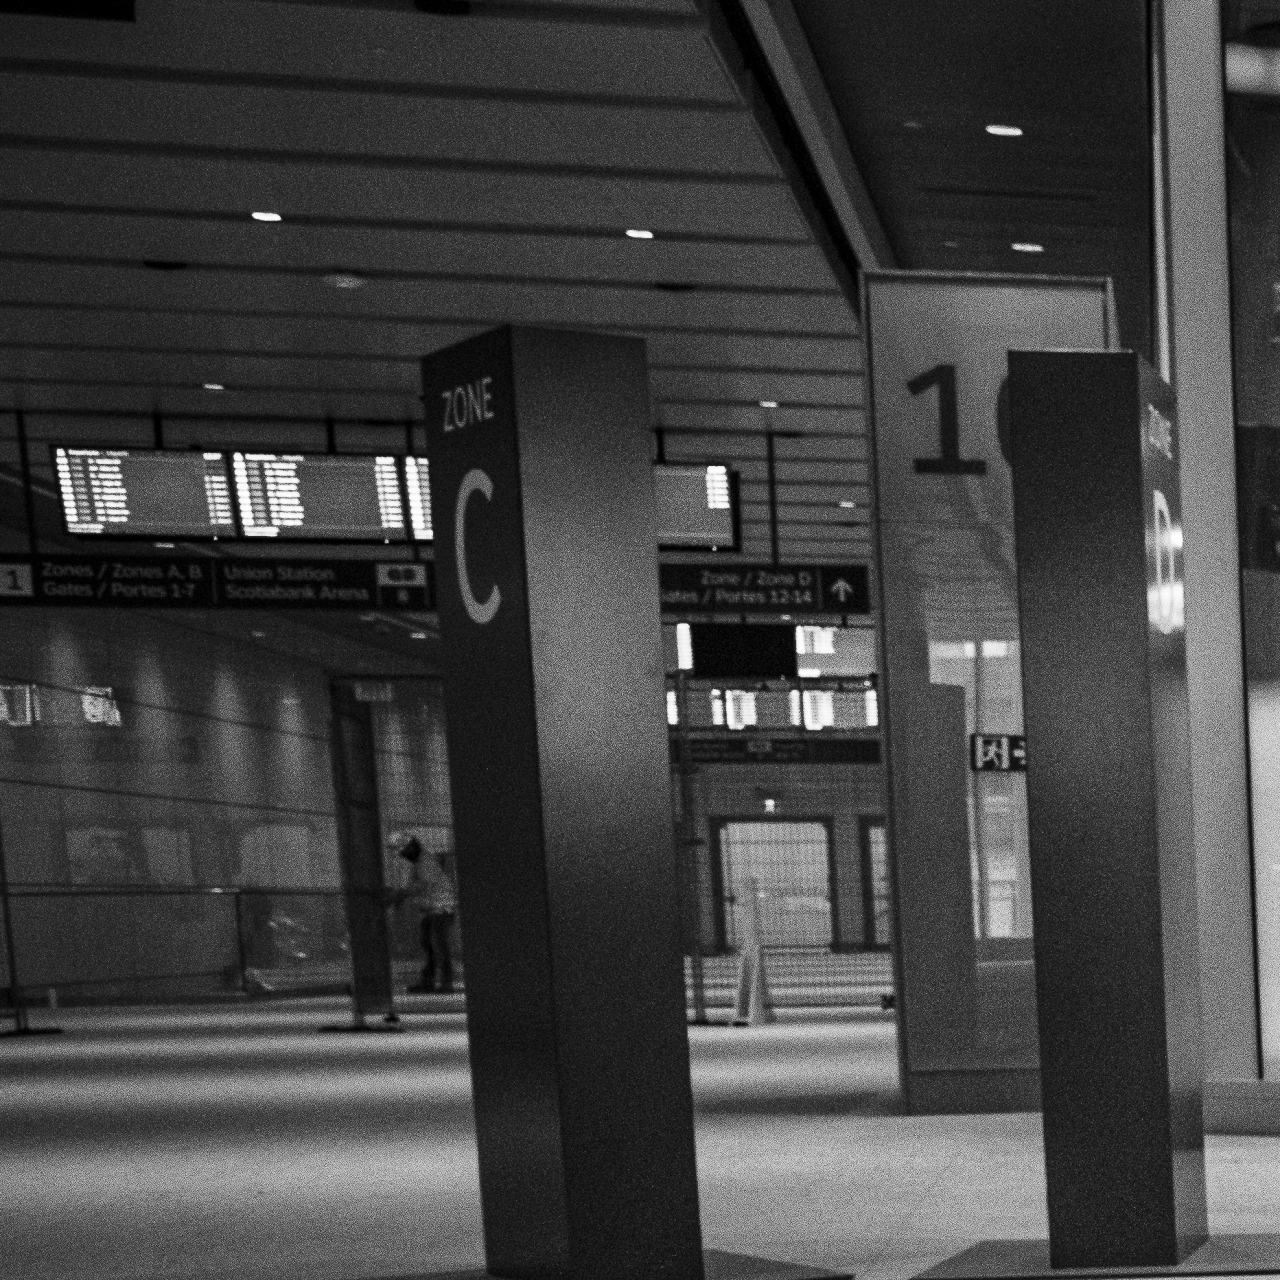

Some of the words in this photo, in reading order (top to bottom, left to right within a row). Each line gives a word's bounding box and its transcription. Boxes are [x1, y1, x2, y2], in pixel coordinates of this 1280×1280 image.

[441, 375, 495, 433] ZONE
[906, 362, 1013, 476] 1
[454, 468, 501, 625] C
[6, 569, 23, 591] 1
[42, 561, 94, 577] Zones
[112, 563, 164, 578] Zones
[43, 581, 94, 597] Gates
[111, 582, 168, 597] Portes
